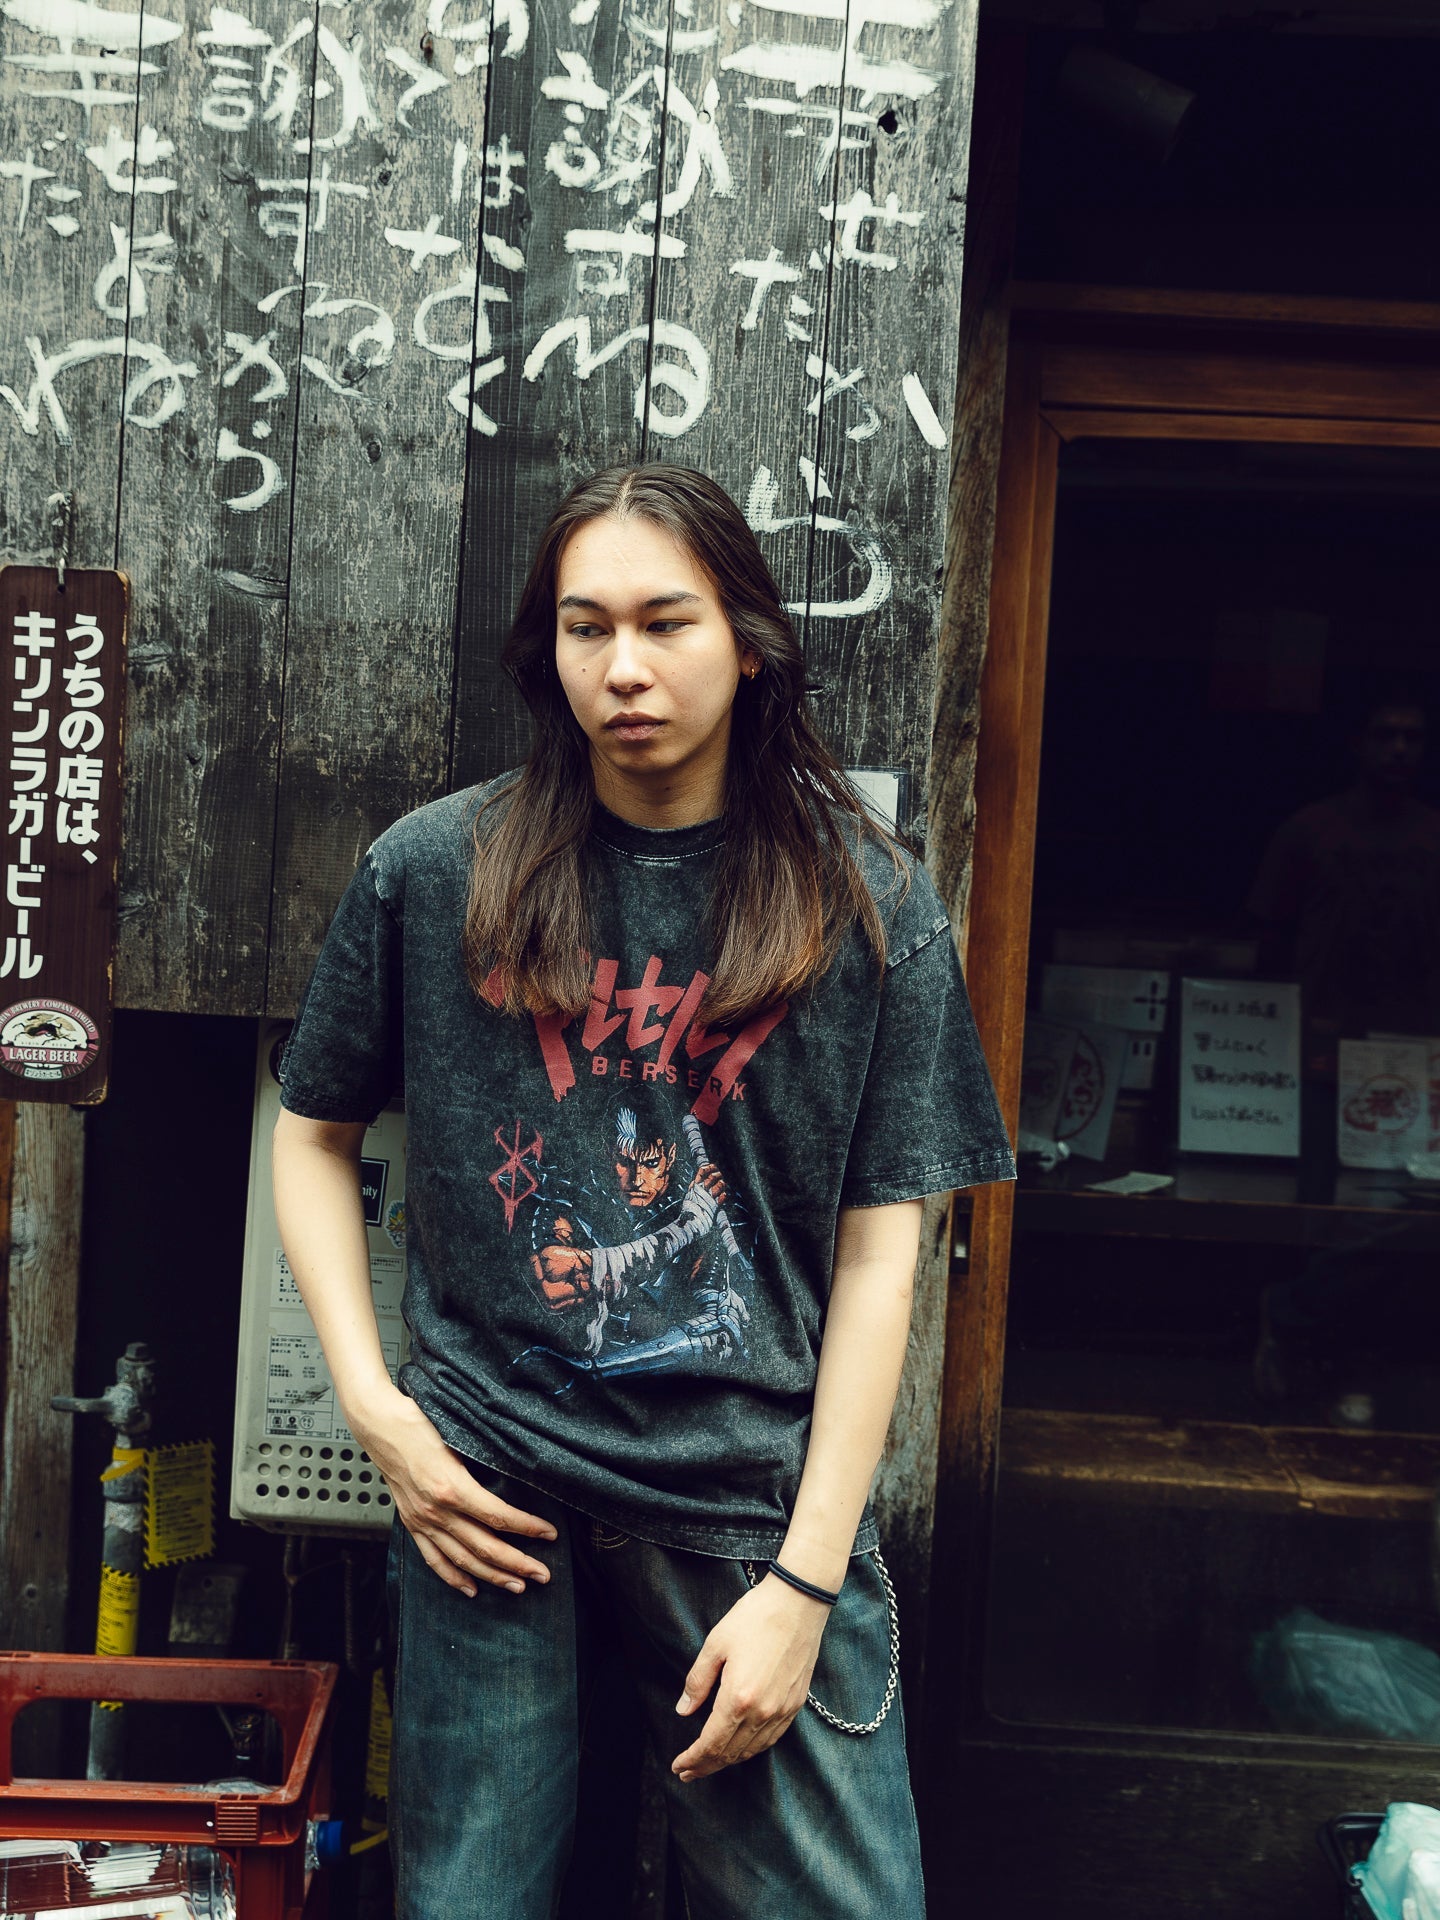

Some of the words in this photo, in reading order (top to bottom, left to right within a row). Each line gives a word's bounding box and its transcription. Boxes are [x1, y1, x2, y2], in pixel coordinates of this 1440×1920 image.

[0, 611, 56, 979] キリンラガービール
[55, 613, 105, 864] うちの店は、
[9, 1048, 47, 1061] LAGER
[49, 1050, 79, 1063] BEER
[591, 1055, 748, 1101] BERSERK
